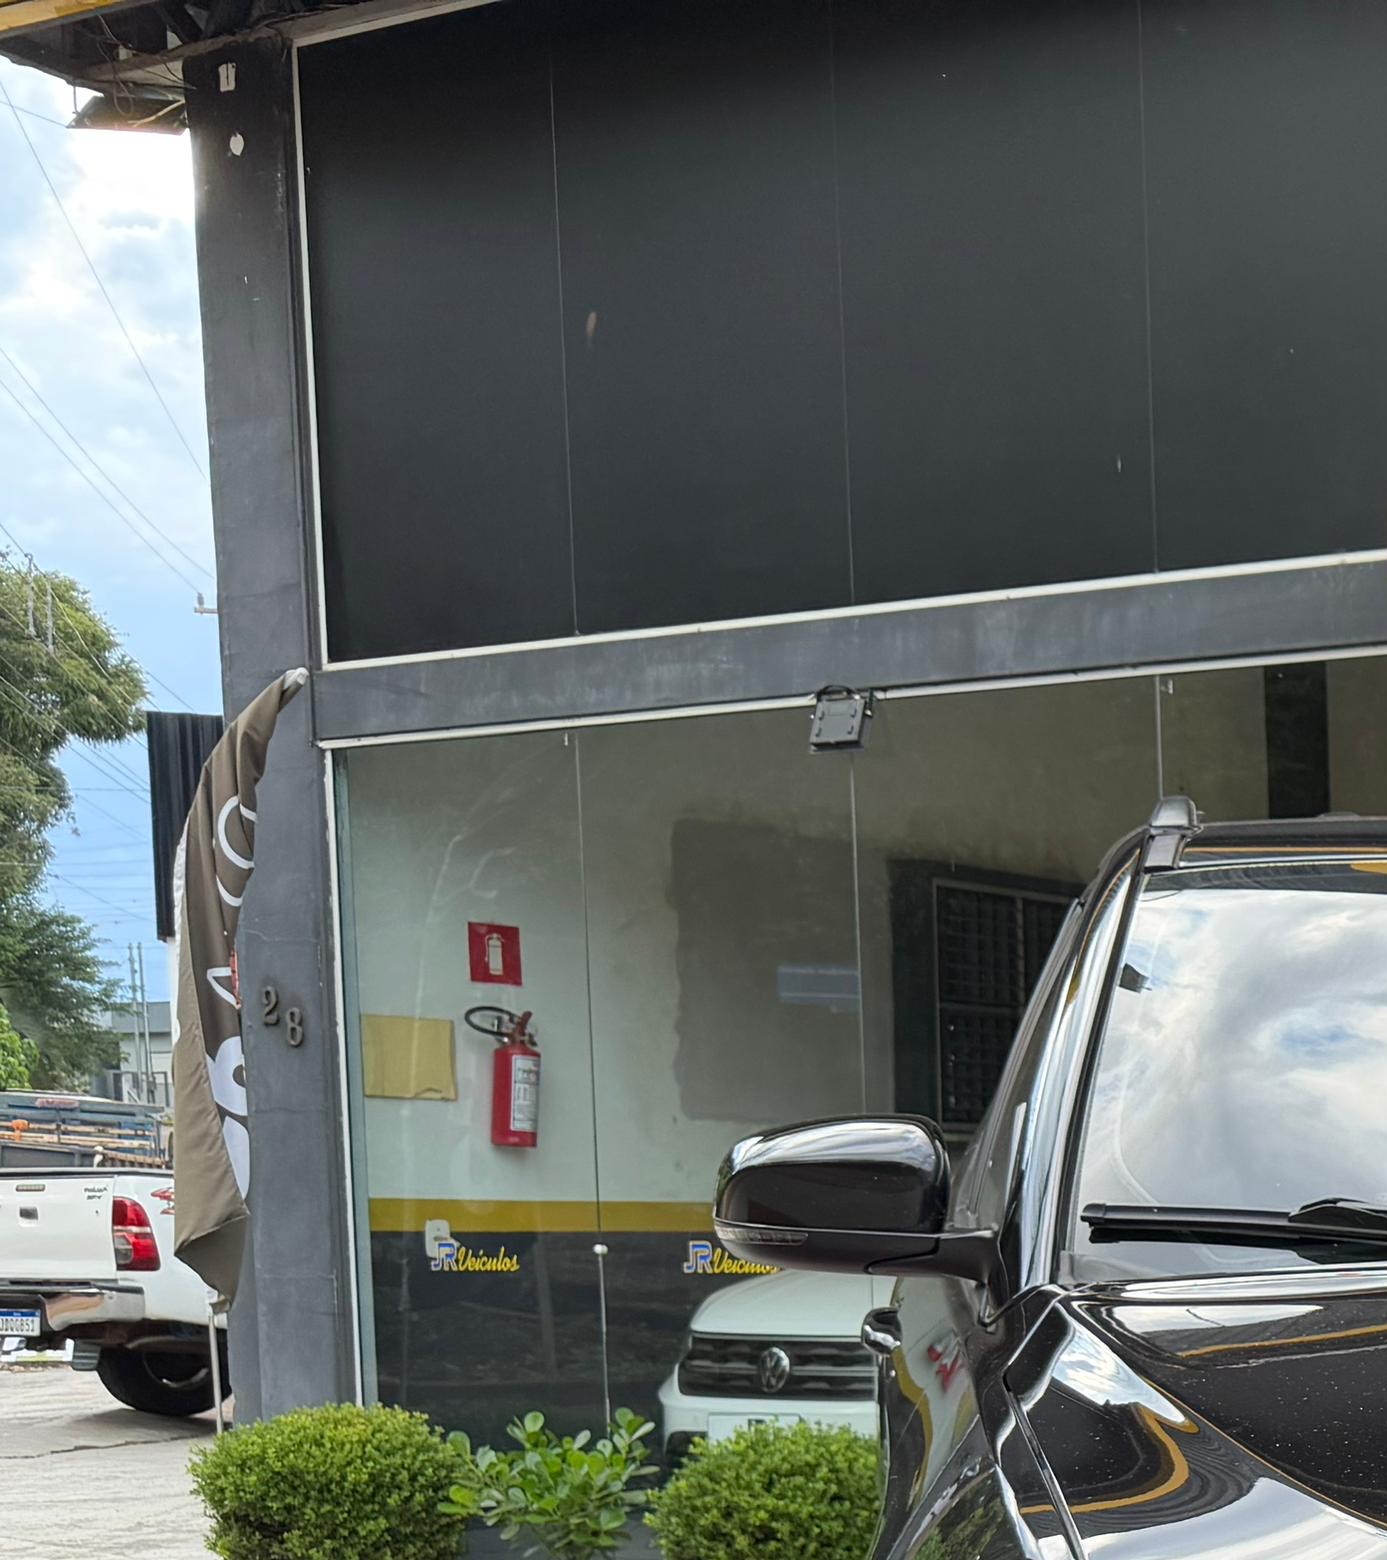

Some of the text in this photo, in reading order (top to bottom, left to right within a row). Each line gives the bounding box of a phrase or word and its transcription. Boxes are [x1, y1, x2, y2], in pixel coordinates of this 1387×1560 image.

[431, 1241, 520, 1273] JR Veículos
[683, 1240, 713, 1274] JR
